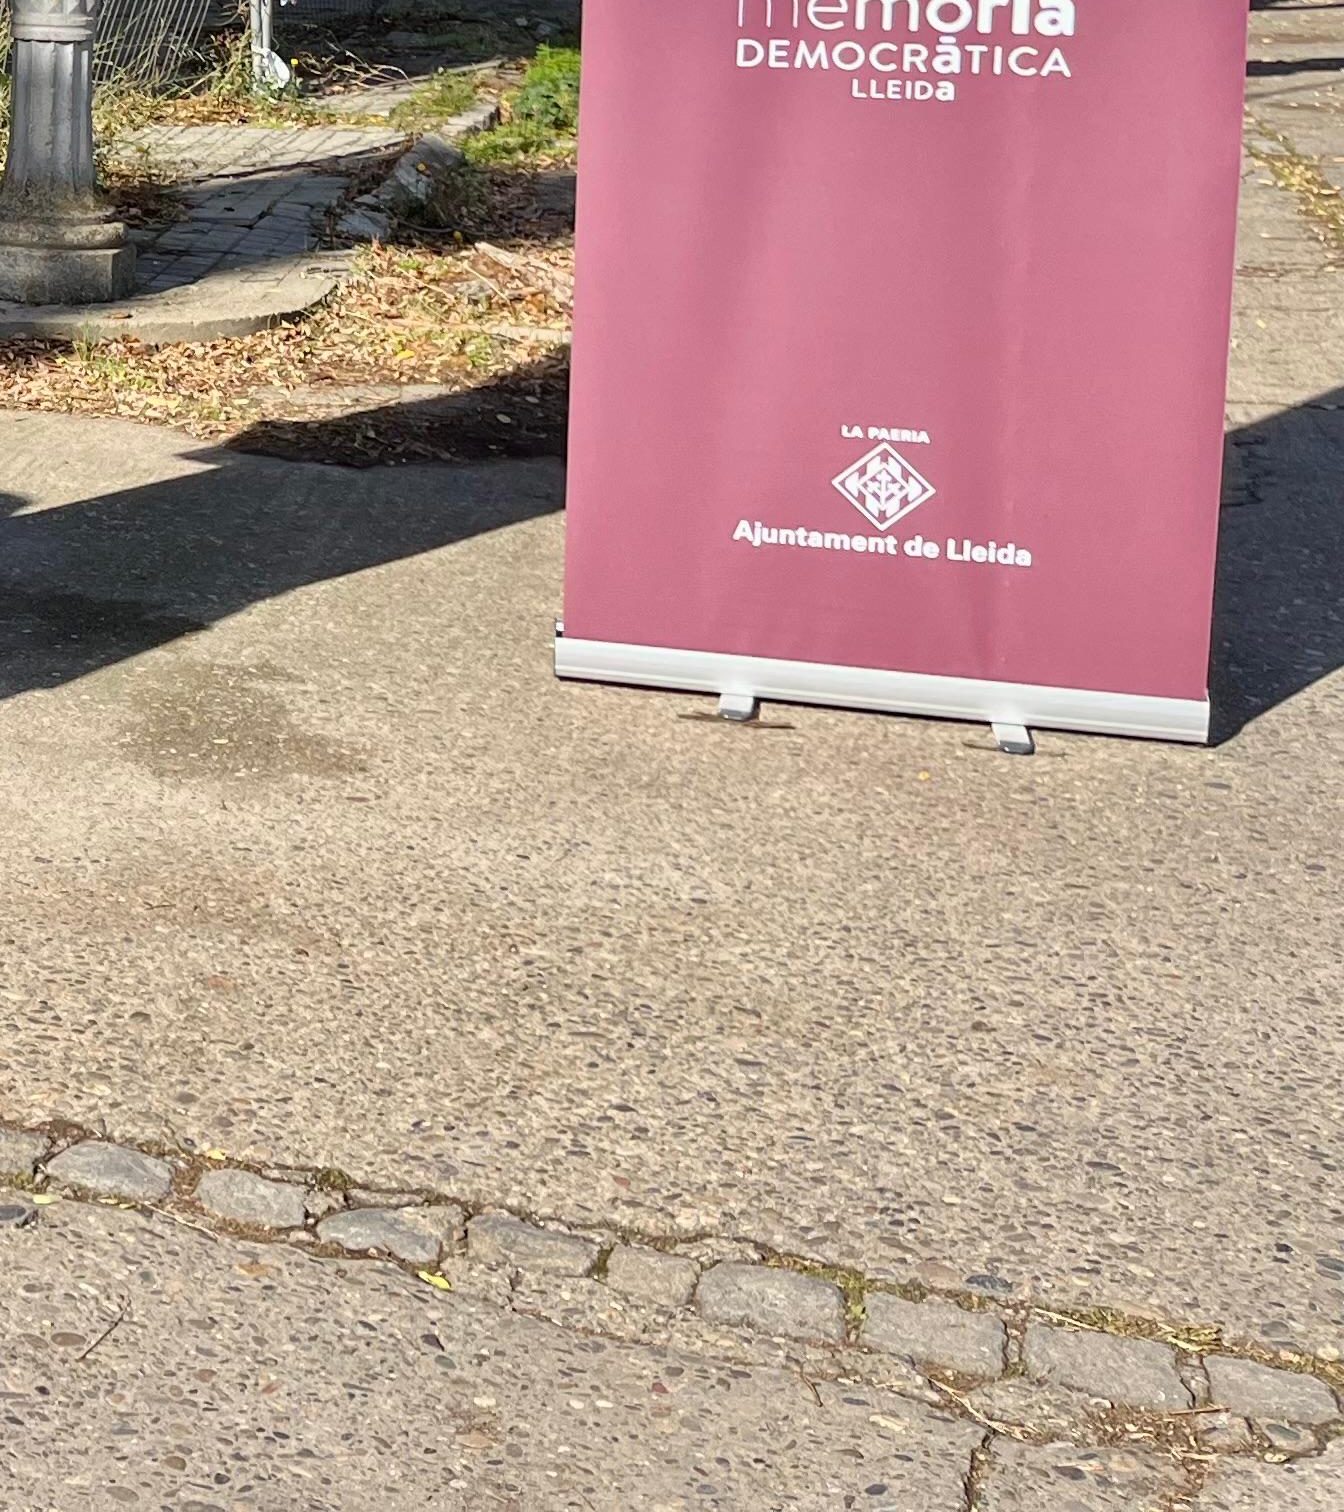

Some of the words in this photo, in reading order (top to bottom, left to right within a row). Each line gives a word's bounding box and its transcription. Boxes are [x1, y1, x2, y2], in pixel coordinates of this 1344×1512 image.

[840, 424, 864, 439] LA
[867, 426, 931, 444] PAERIA
[732, 519, 898, 556] Ajuntament
[903, 535, 940, 559] de
[946, 539, 1032, 567] Lleida
